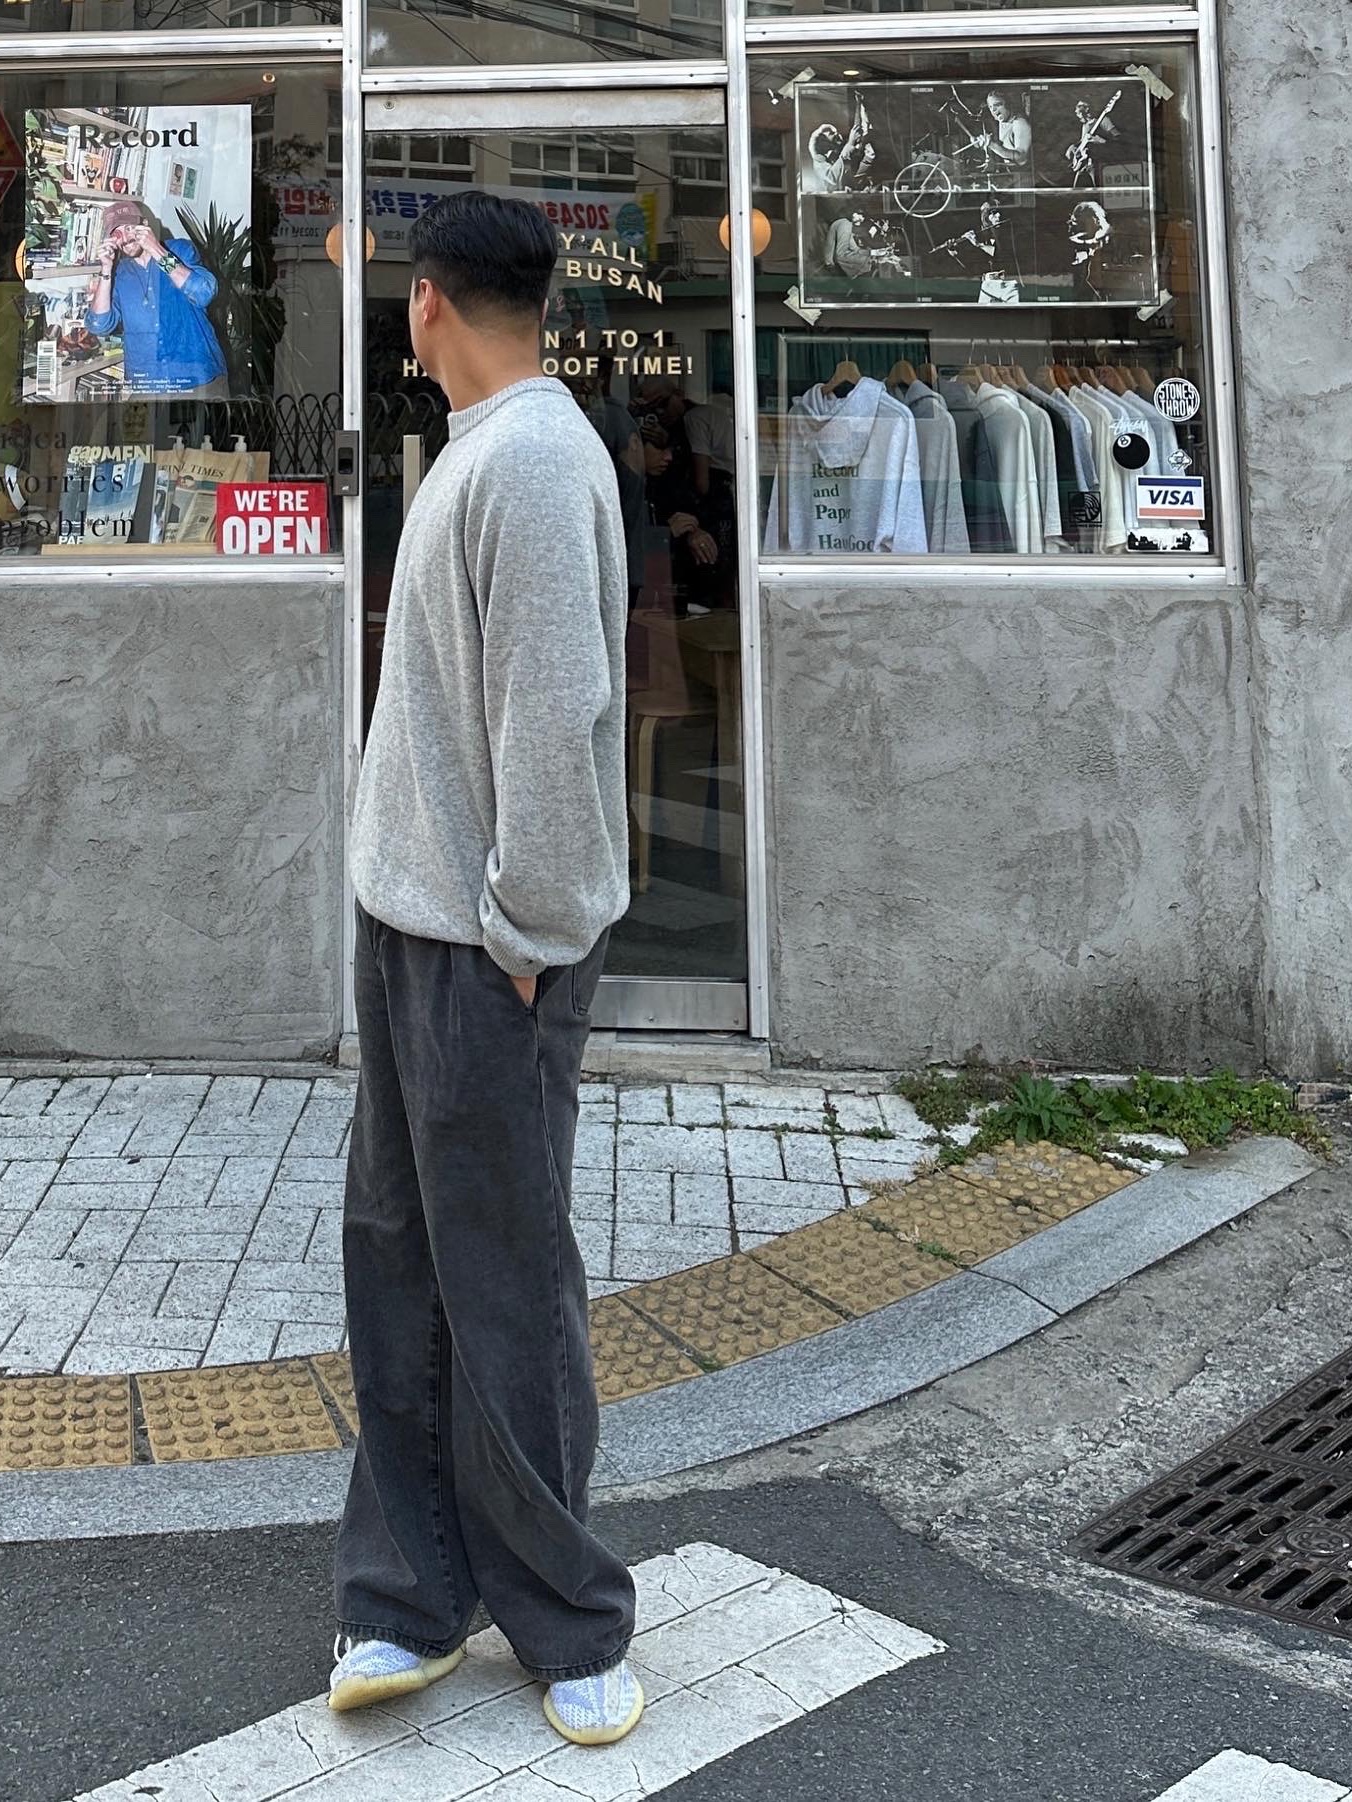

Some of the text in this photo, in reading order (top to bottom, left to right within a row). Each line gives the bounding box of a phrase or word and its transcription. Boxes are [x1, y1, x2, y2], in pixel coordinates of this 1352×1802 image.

[77, 121, 199, 149] Record
[559, 233, 644, 269] Y'ALL
[566, 259, 663, 305] BUSAN
[576, 330, 586, 348] 1
[602, 329, 638, 348] TO
[653, 330, 664, 347] 1
[402, 358, 428, 378] H
[613, 356, 694, 375] TIME!
[1158, 382, 1196, 400] STONES
[1160, 399, 1195, 416] THROW
[191, 464, 225, 479] TIMES
[811, 463, 859, 479] Record
[233, 489, 309, 512] WE'RE
[813, 484, 840, 498] and
[1149, 490, 1194, 506] VISA
[222, 516, 321, 554] OPEN
